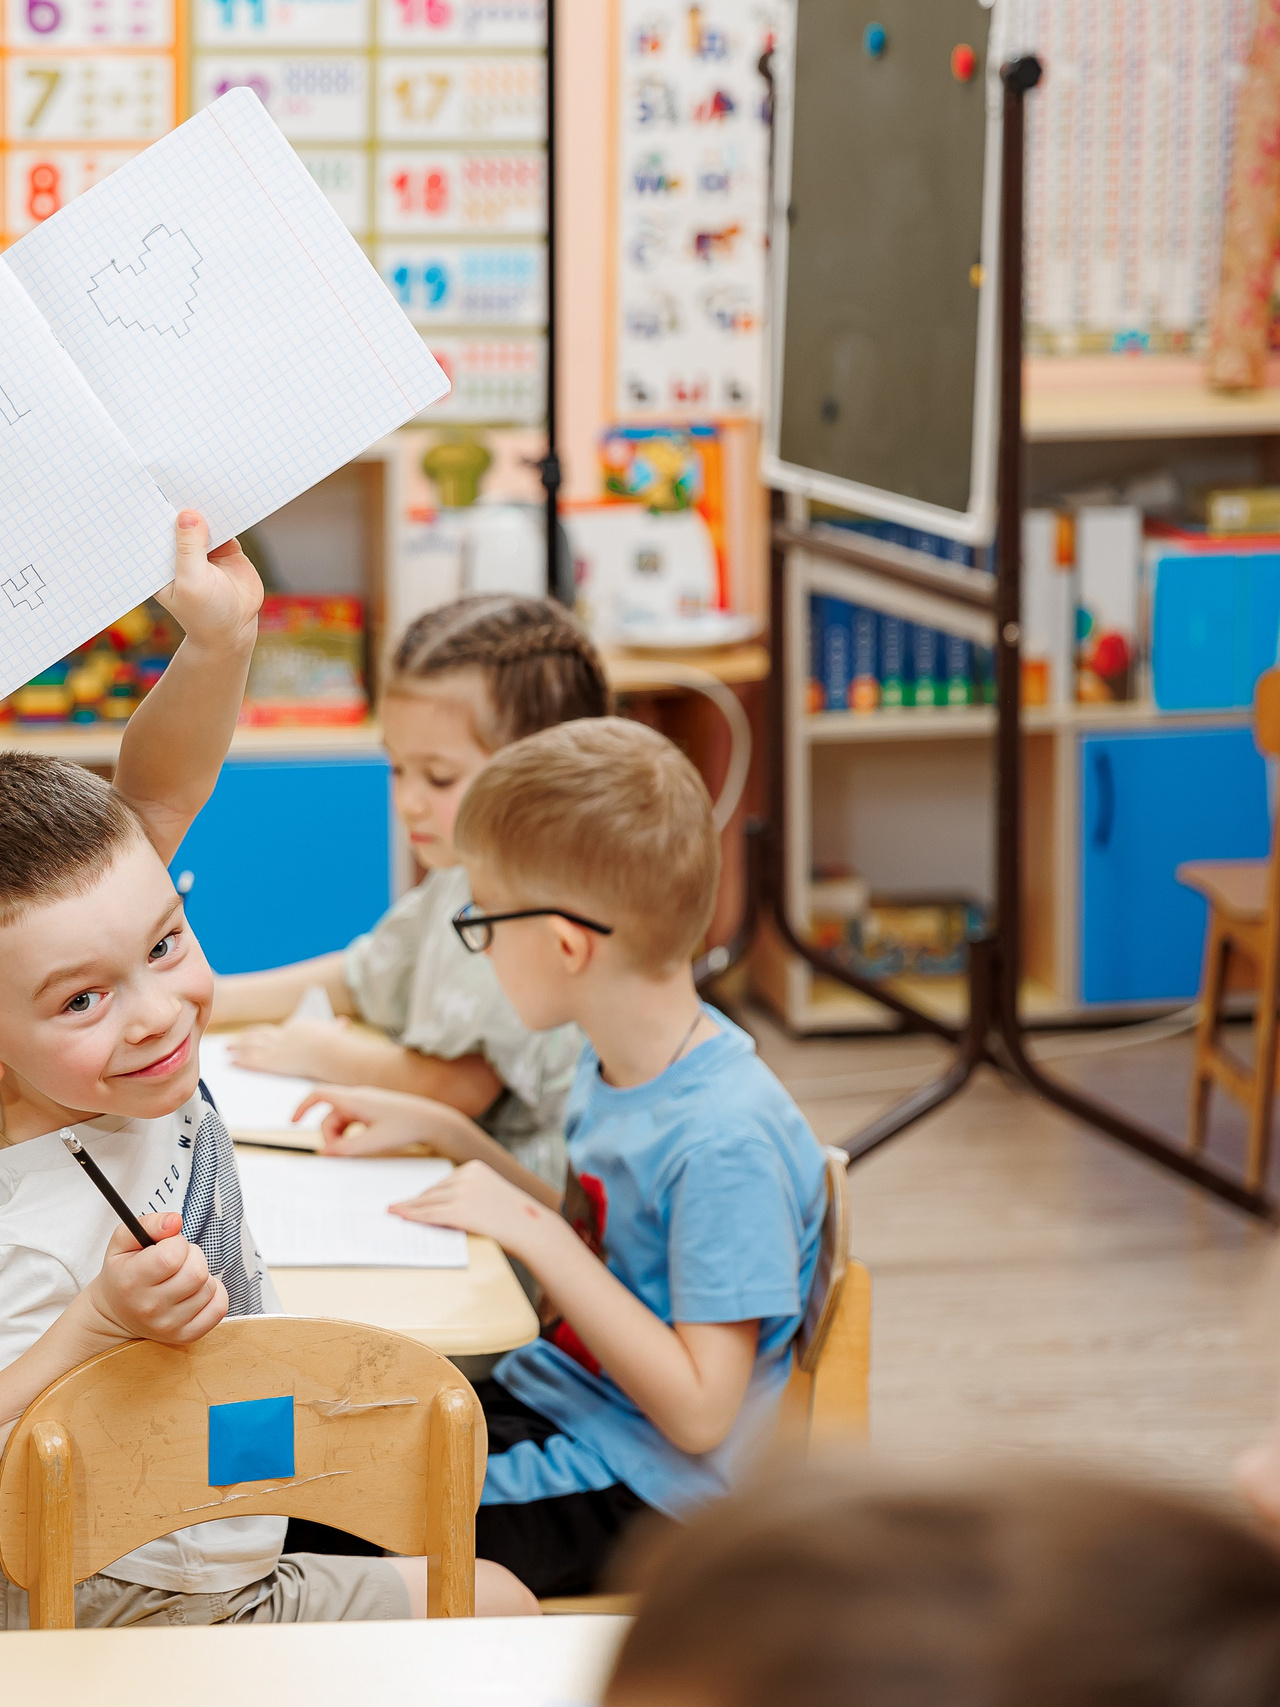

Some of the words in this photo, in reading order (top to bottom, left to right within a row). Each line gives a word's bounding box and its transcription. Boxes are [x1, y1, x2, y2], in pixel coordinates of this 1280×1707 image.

[27, 69, 61, 128] 7
[393, 71, 450, 123] 17
[28, 162, 61, 221] 8
[392, 167, 449, 216] 18
[392, 262, 449, 313] 19
[139, 1164, 180, 1217] ITED
